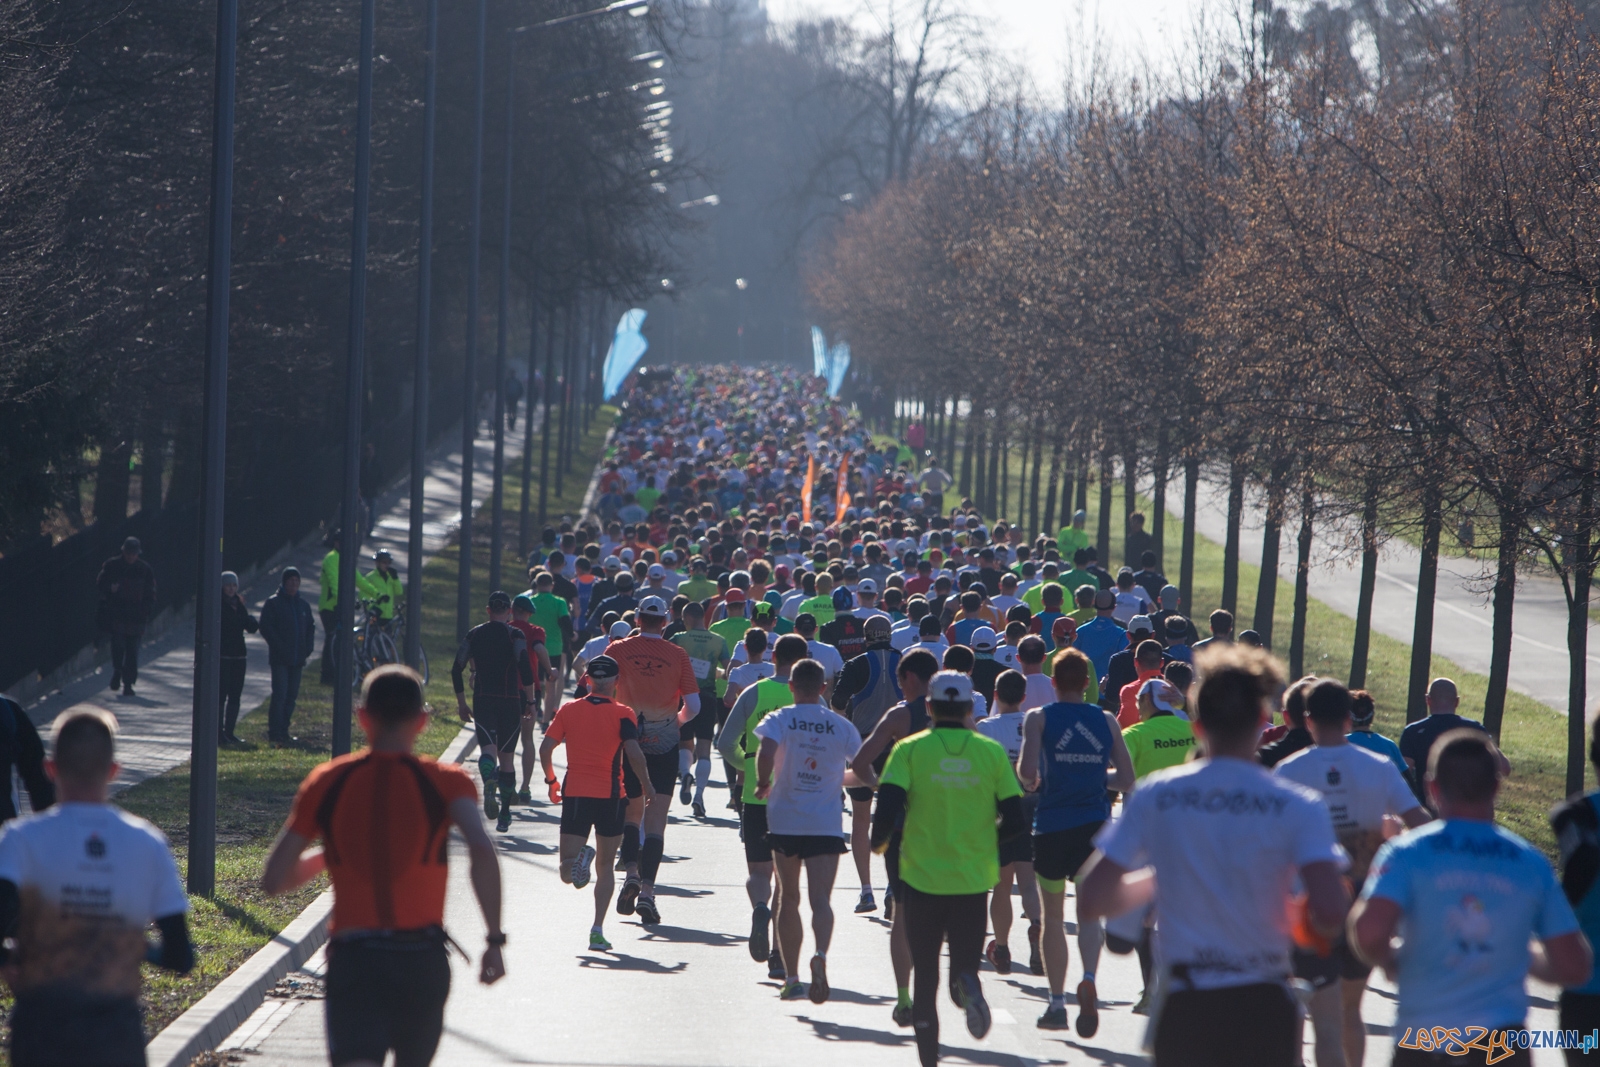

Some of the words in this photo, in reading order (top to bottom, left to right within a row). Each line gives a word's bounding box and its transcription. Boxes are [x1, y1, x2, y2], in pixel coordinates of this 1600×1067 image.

[788, 717, 835, 735] Jarek
[1055, 727, 1074, 751] TKKF
[1074, 721, 1104, 753] WODNIK
[1153, 736, 1196, 749] Robert
